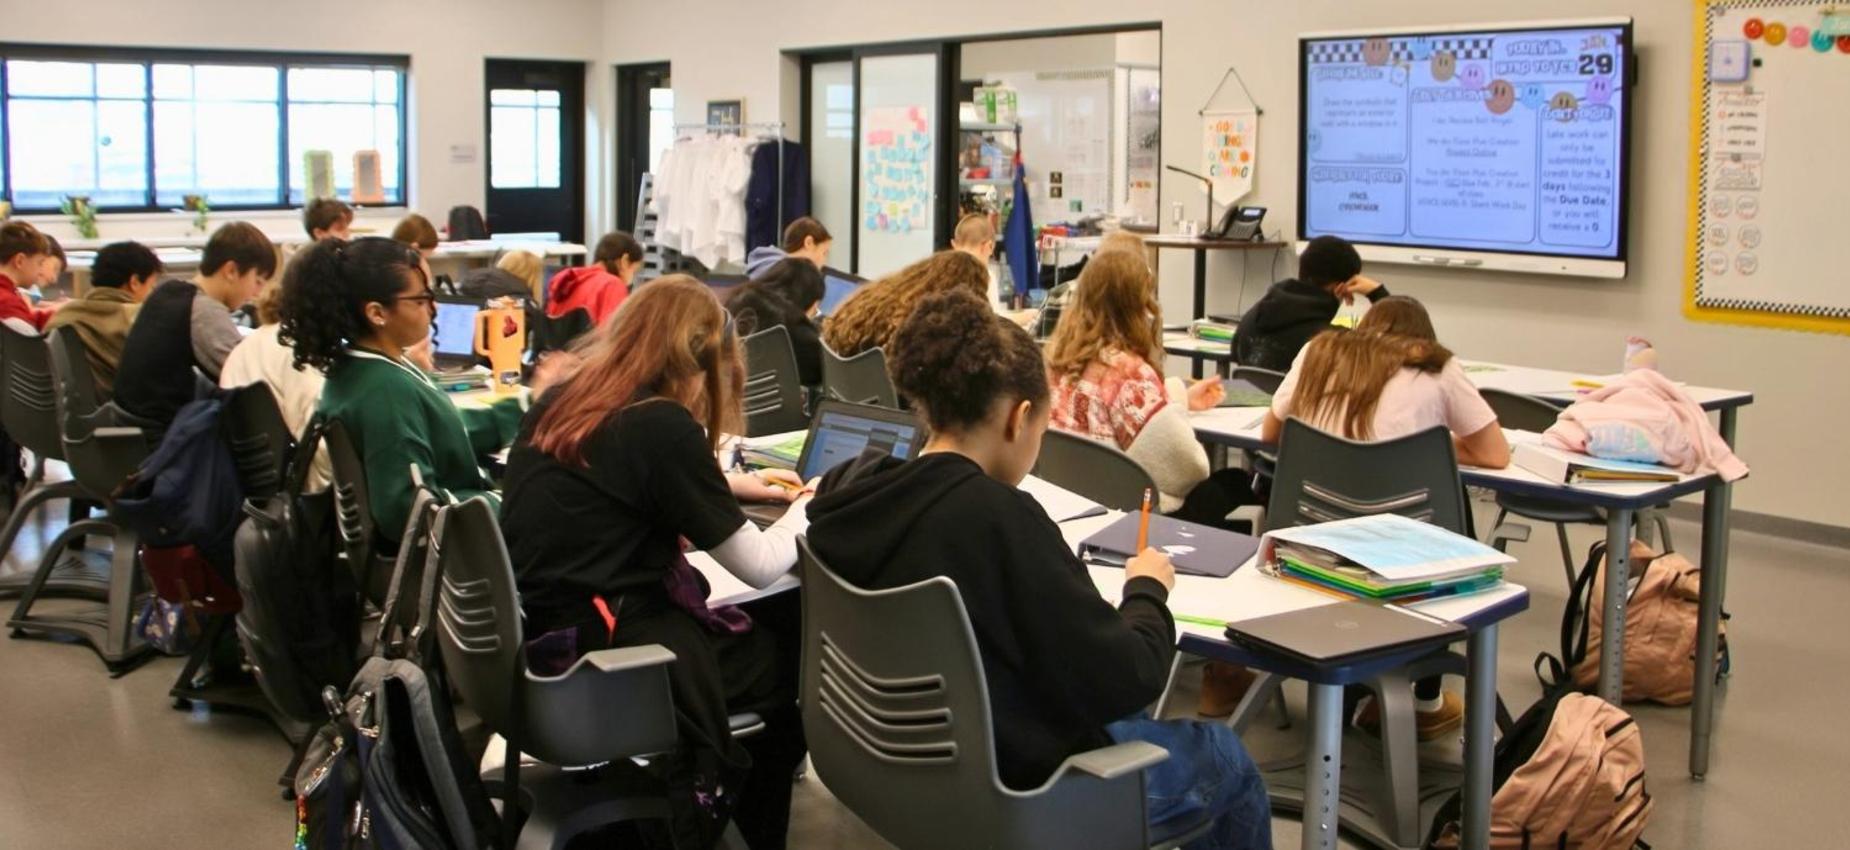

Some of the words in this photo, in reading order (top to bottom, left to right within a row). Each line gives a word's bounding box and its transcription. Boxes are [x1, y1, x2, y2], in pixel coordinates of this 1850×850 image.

[1578, 54, 1613, 75] 29
[1568, 128, 1589, 139] work
[1542, 181, 1567, 194] days
[1560, 194, 1580, 206] Due
